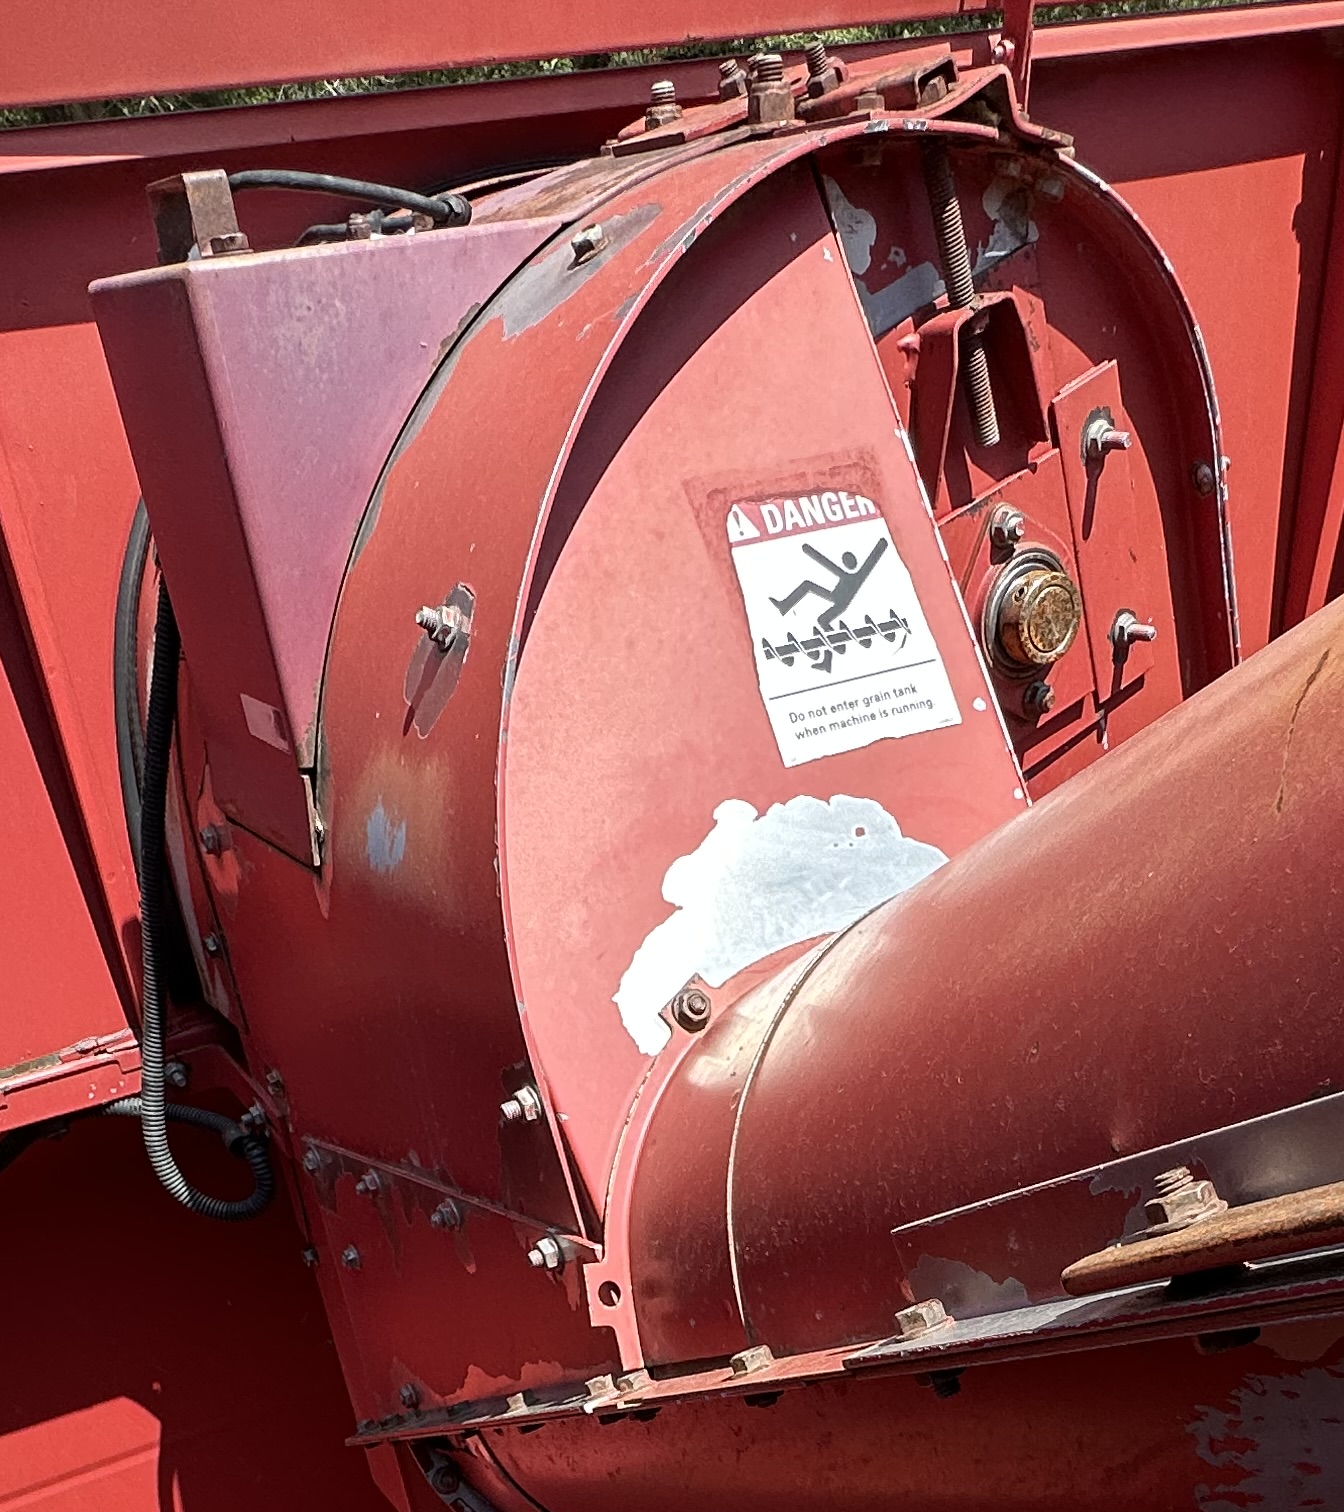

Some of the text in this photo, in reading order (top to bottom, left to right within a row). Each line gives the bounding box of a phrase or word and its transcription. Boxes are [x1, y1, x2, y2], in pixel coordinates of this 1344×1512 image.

[789, 683, 918, 724] Do not enter grain tank
[795, 724, 826, 740] when
[829, 713, 876, 731] machine
[879, 707, 889, 719] is
